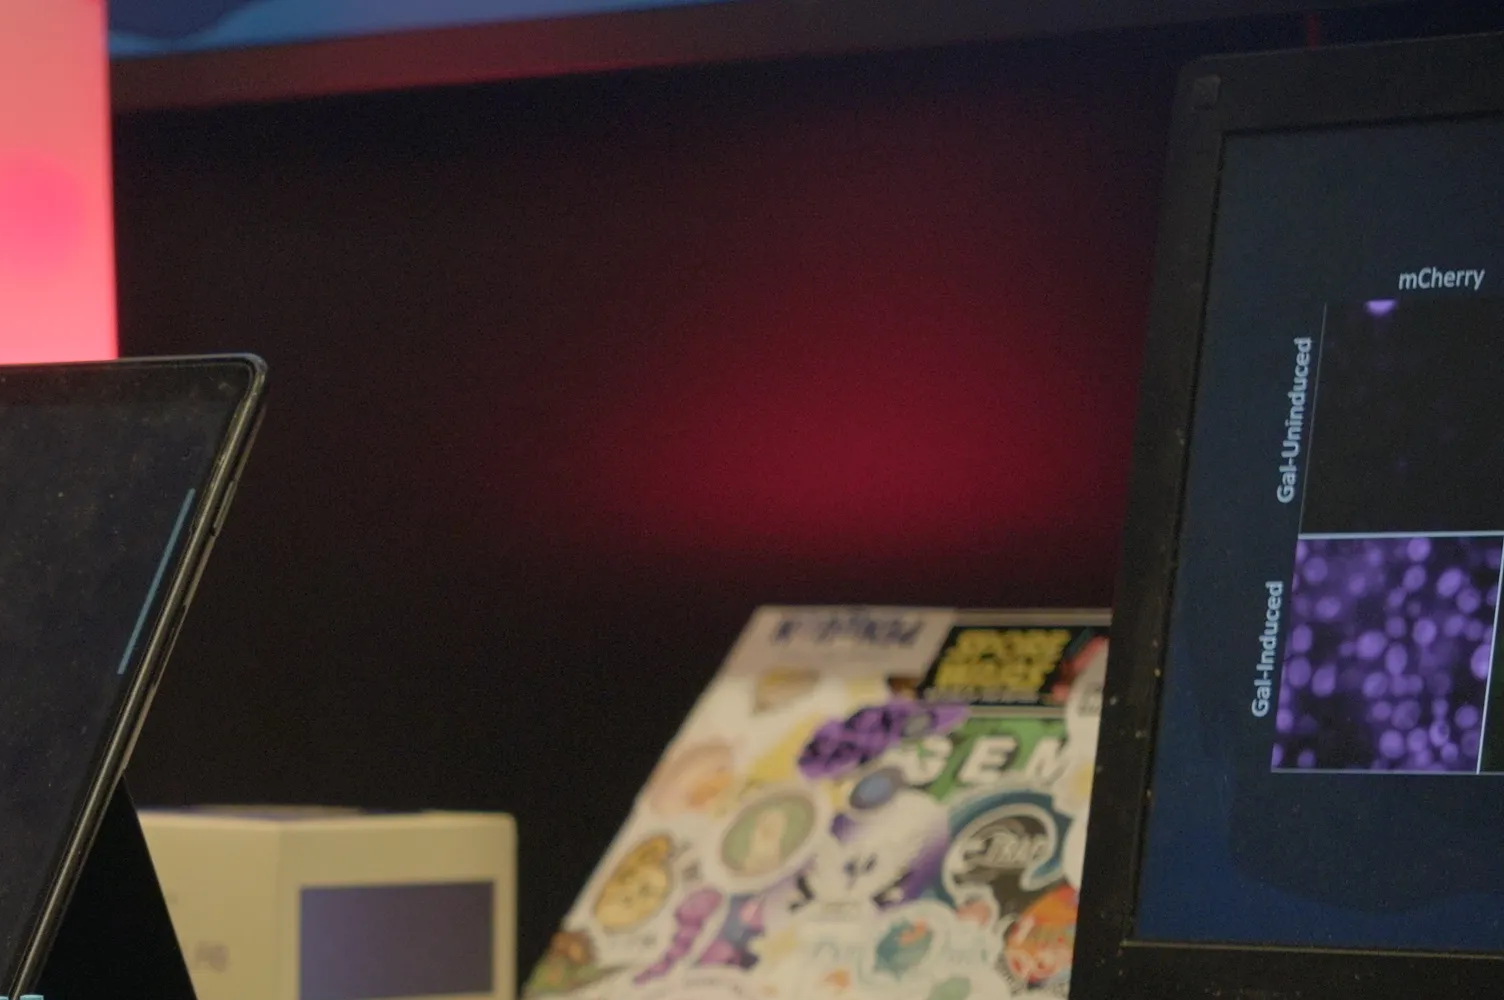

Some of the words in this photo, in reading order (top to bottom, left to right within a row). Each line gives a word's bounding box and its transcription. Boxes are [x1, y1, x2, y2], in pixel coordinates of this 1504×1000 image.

[1398, 266, 1486, 290] mCherry
[1276, 336, 1313, 503] Gal-Uninduced
[1251, 580, 1284, 718] Gal-Induced
